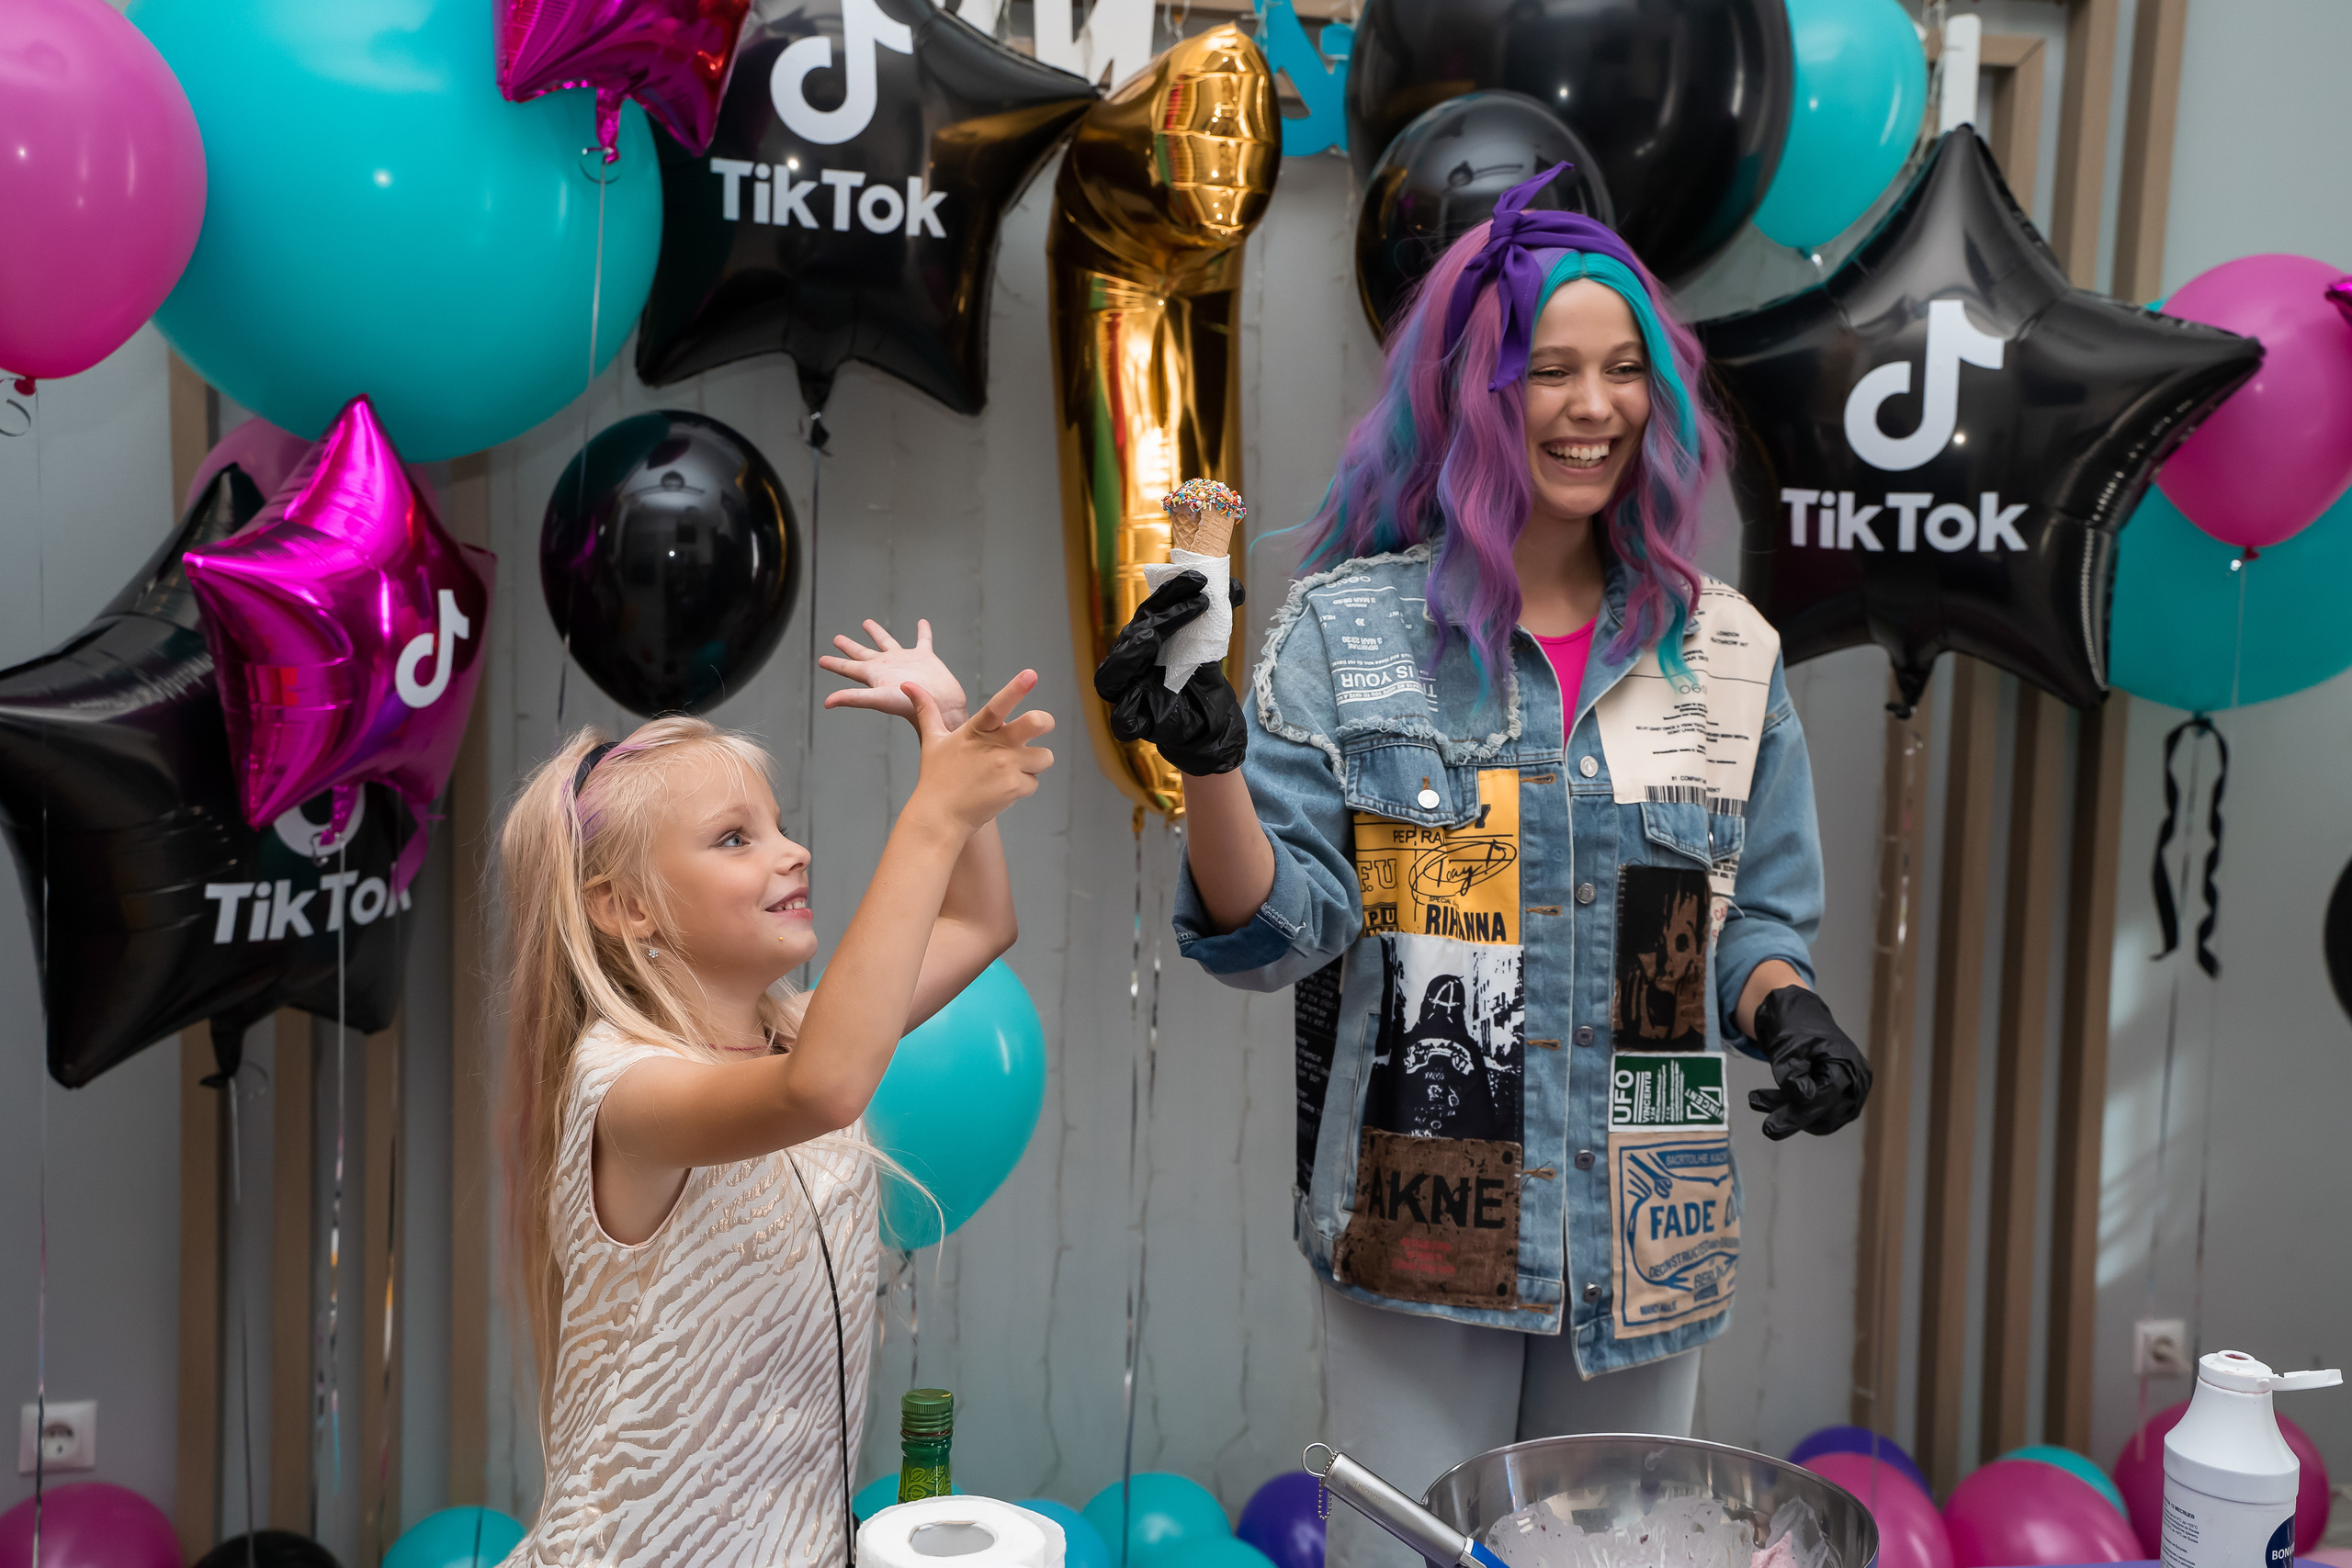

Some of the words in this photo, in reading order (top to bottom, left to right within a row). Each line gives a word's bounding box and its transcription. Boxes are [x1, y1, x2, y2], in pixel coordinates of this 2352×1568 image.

[709, 157, 948, 239] TikTok
[1780, 487, 2030, 553] TikTok
[1340, 671, 1393, 688] YOUR
[1396, 665, 1415, 679] IS
[1425, 903, 1507, 942] RIHANNA
[1612, 1069, 1634, 1123] UFO
[1368, 1166, 1506, 1230] AKNE
[1649, 1200, 1716, 1241] FADE
